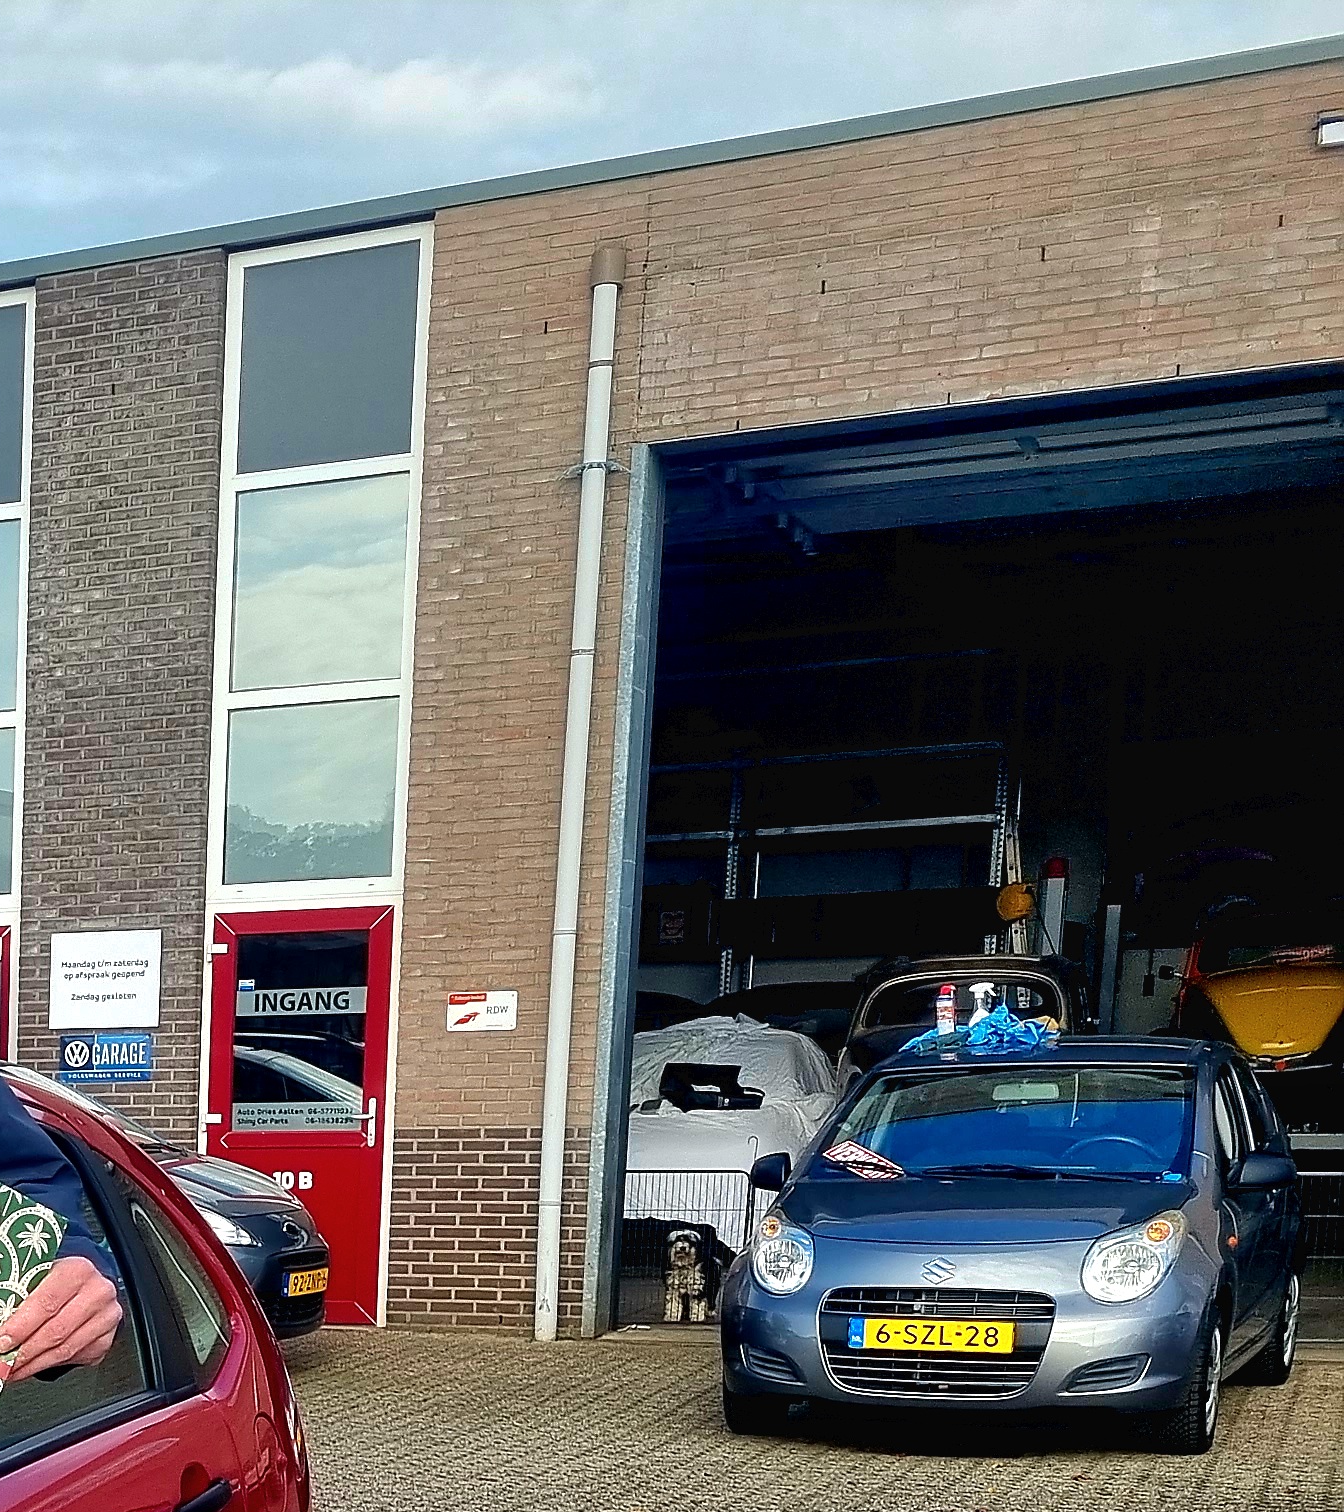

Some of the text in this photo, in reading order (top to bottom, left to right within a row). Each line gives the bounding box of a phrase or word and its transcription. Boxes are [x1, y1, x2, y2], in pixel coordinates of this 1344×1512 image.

[61, 959, 149, 970] Maandag t/m zaterdag
[64, 973, 74, 981] op
[75, 970, 110, 980] afspraak
[101, 992, 137, 1002] gesloten
[254, 990, 350, 1013] INGANG
[486, 1005, 509, 1014] RDW
[92, 1042, 147, 1065] GARAGE
[236, 1108, 255, 1116] Auto
[236, 1118, 256, 1127] Shiny
[269, 1117, 289, 1125] Parts
[273, 1171, 313, 1190] 10 B
[875, 1323, 999, 1348] 6-SZL-28
